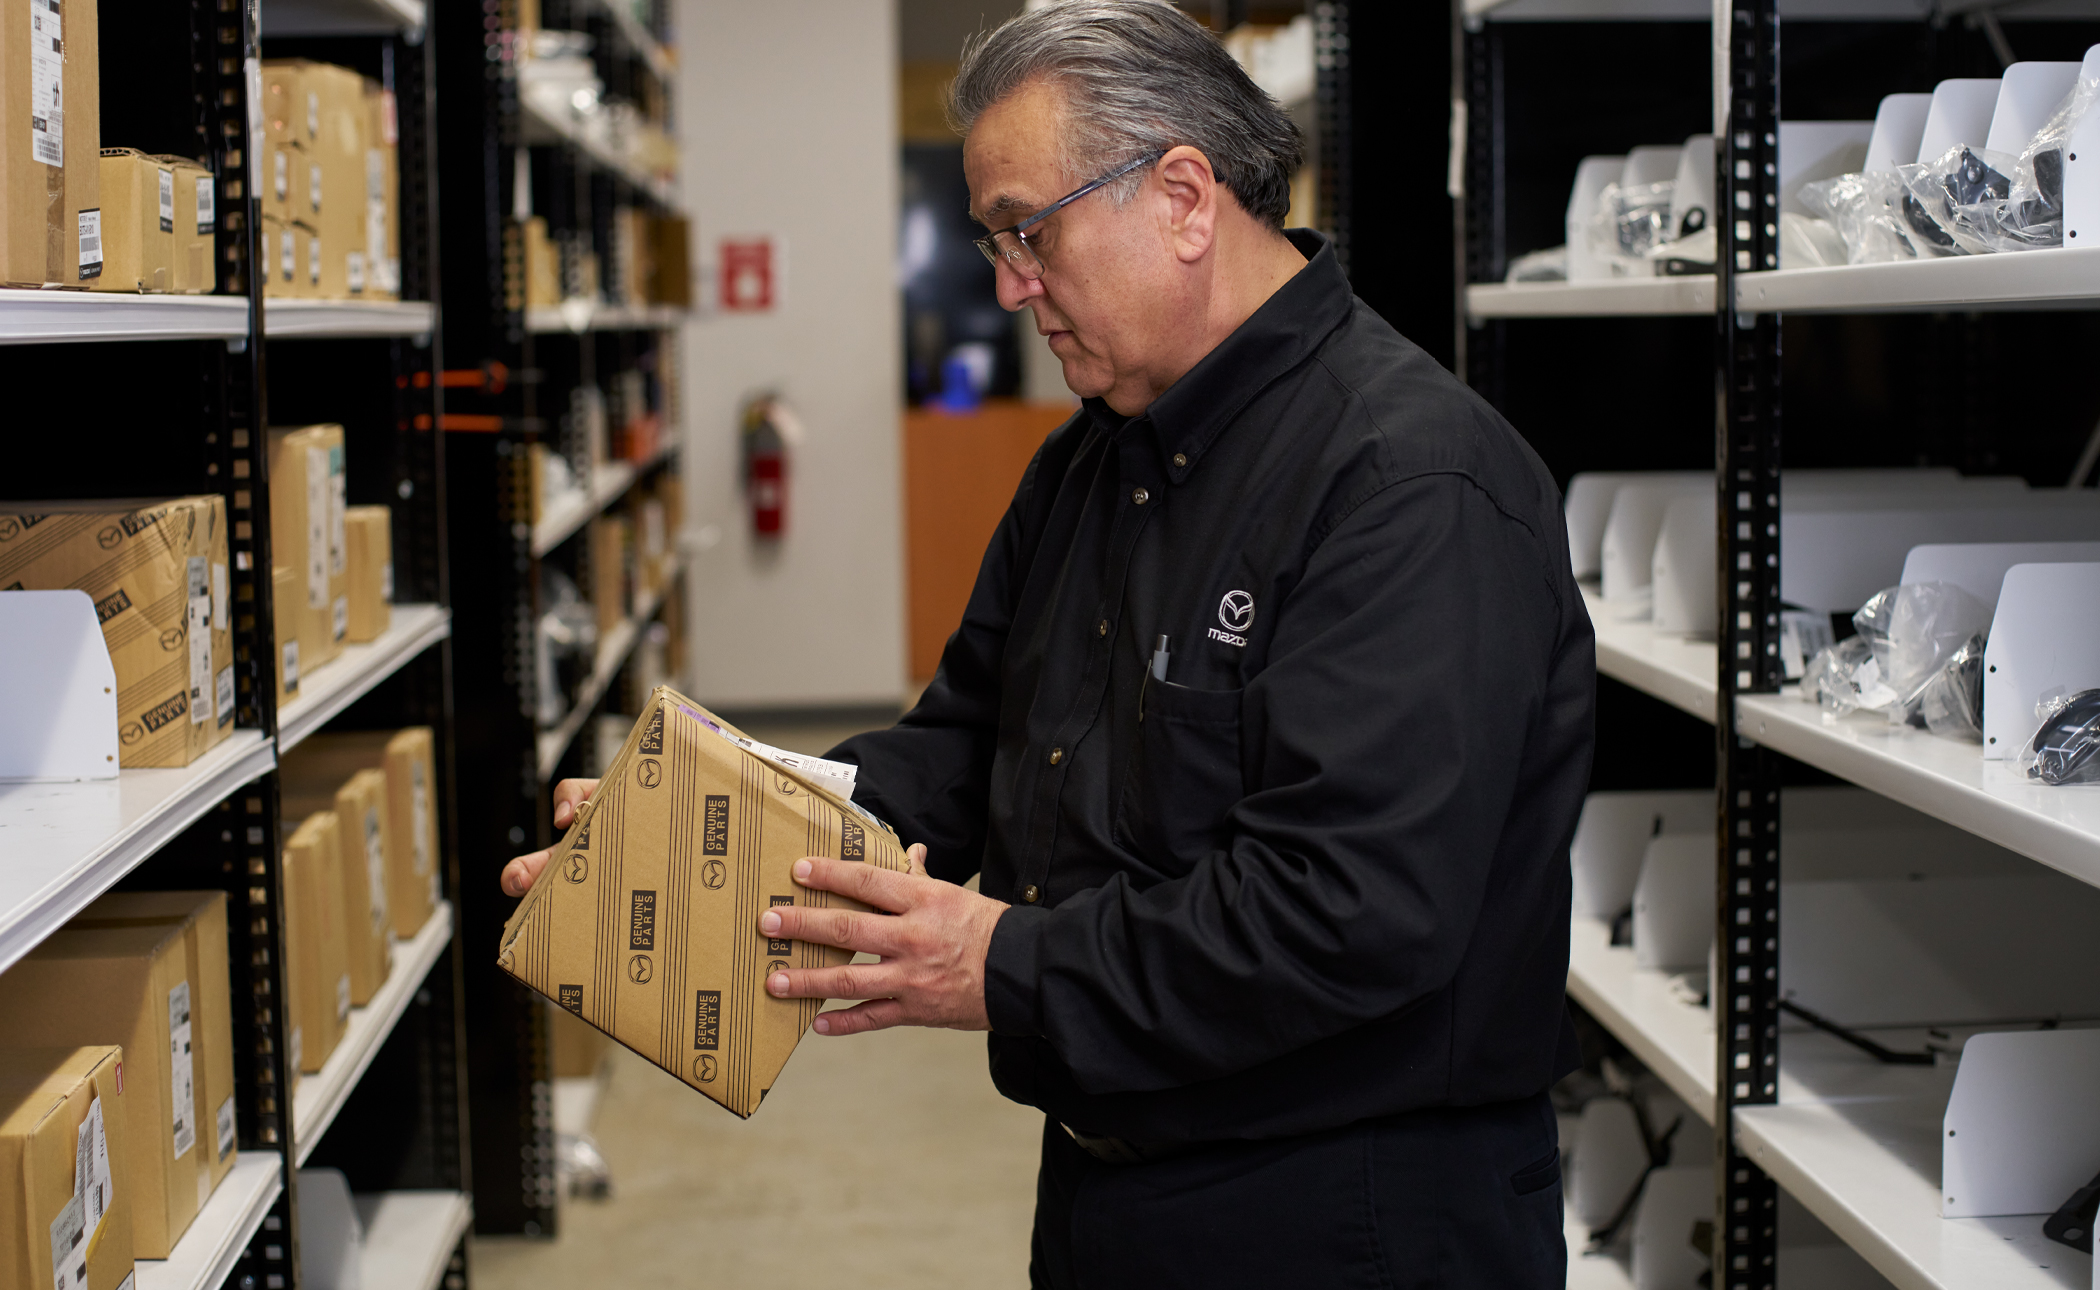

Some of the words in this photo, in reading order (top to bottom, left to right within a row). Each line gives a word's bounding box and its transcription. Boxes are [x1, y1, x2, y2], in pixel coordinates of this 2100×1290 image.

[145, 695, 185, 722] GENUINE
[150, 701, 187, 730] PARTS
[706, 800, 717, 850] GENUINE
[715, 800, 727, 850] PARTS
[853, 826, 863, 856] PAR
[632, 895, 644, 945] GENUINE
[642, 895, 653, 945] PARTS
[697, 995, 709, 1045] GENUINE
[707, 995, 718, 1045] PARTS
